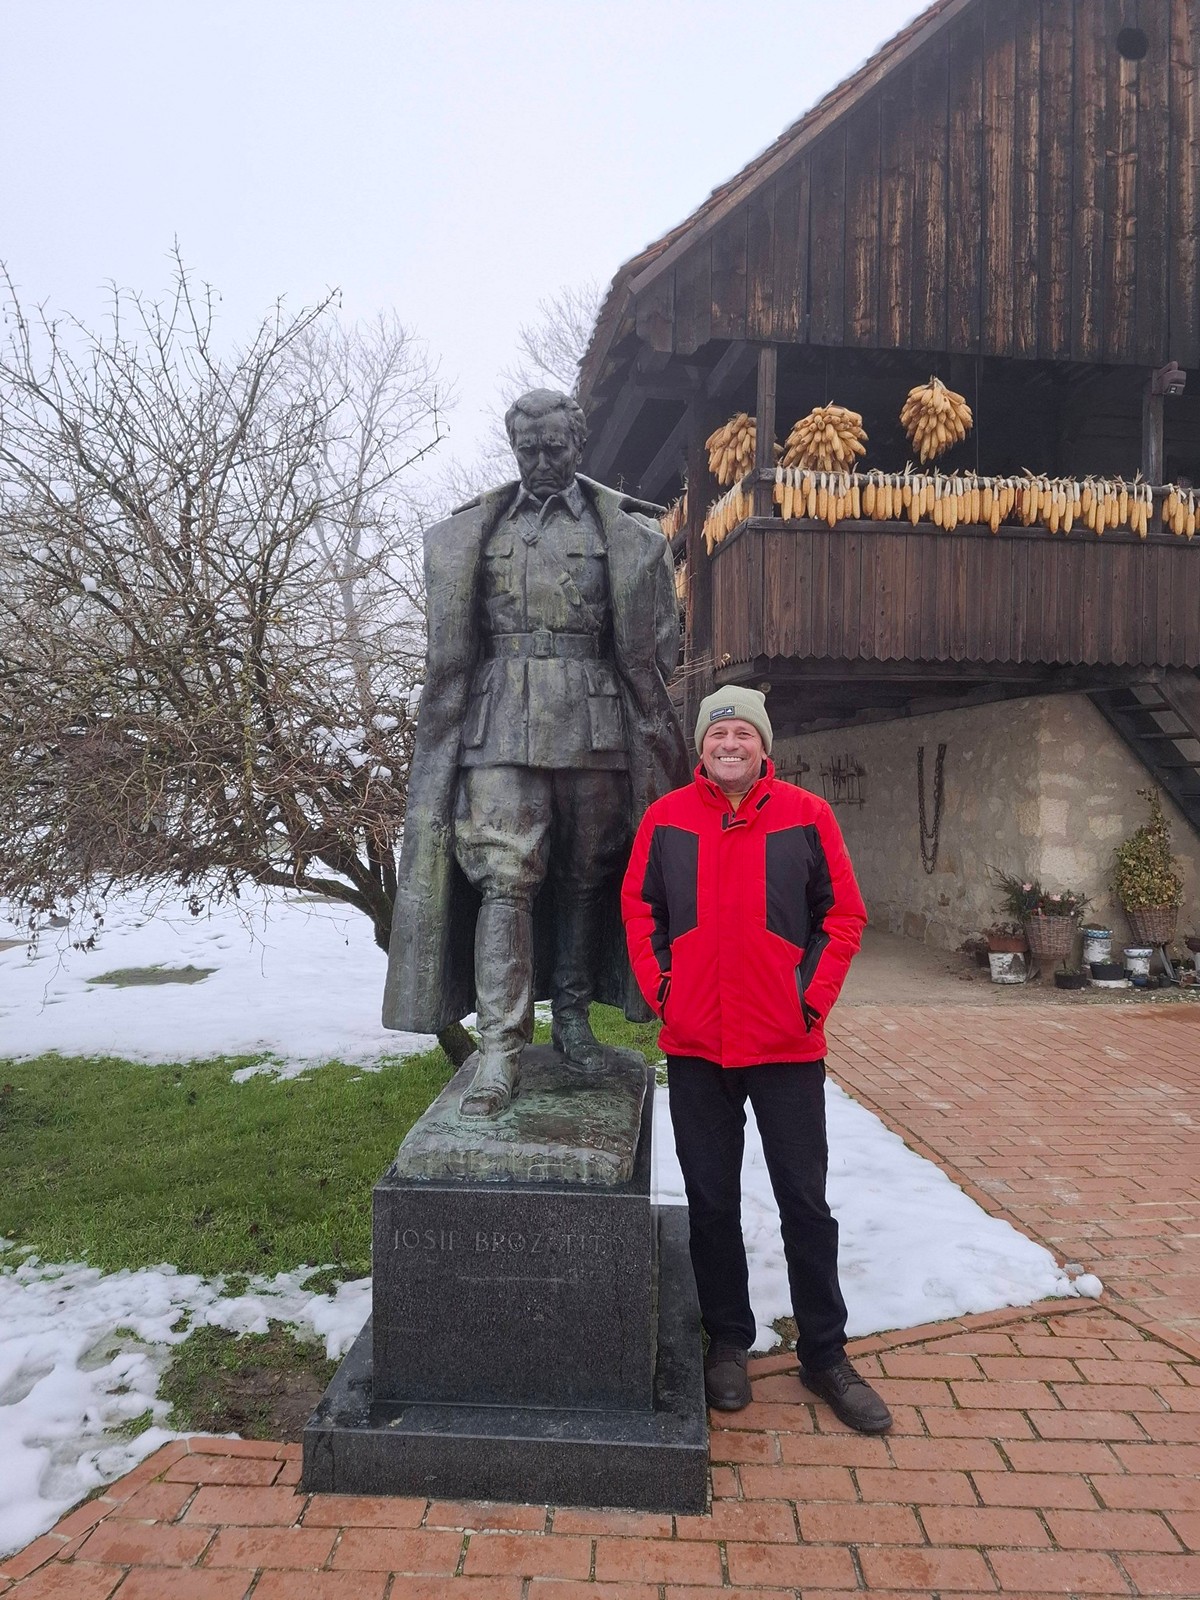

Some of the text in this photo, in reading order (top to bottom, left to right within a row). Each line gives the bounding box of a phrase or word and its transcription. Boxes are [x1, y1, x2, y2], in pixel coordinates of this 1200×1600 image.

[394, 1229, 625, 1256] JOSIP BROZ TITO
